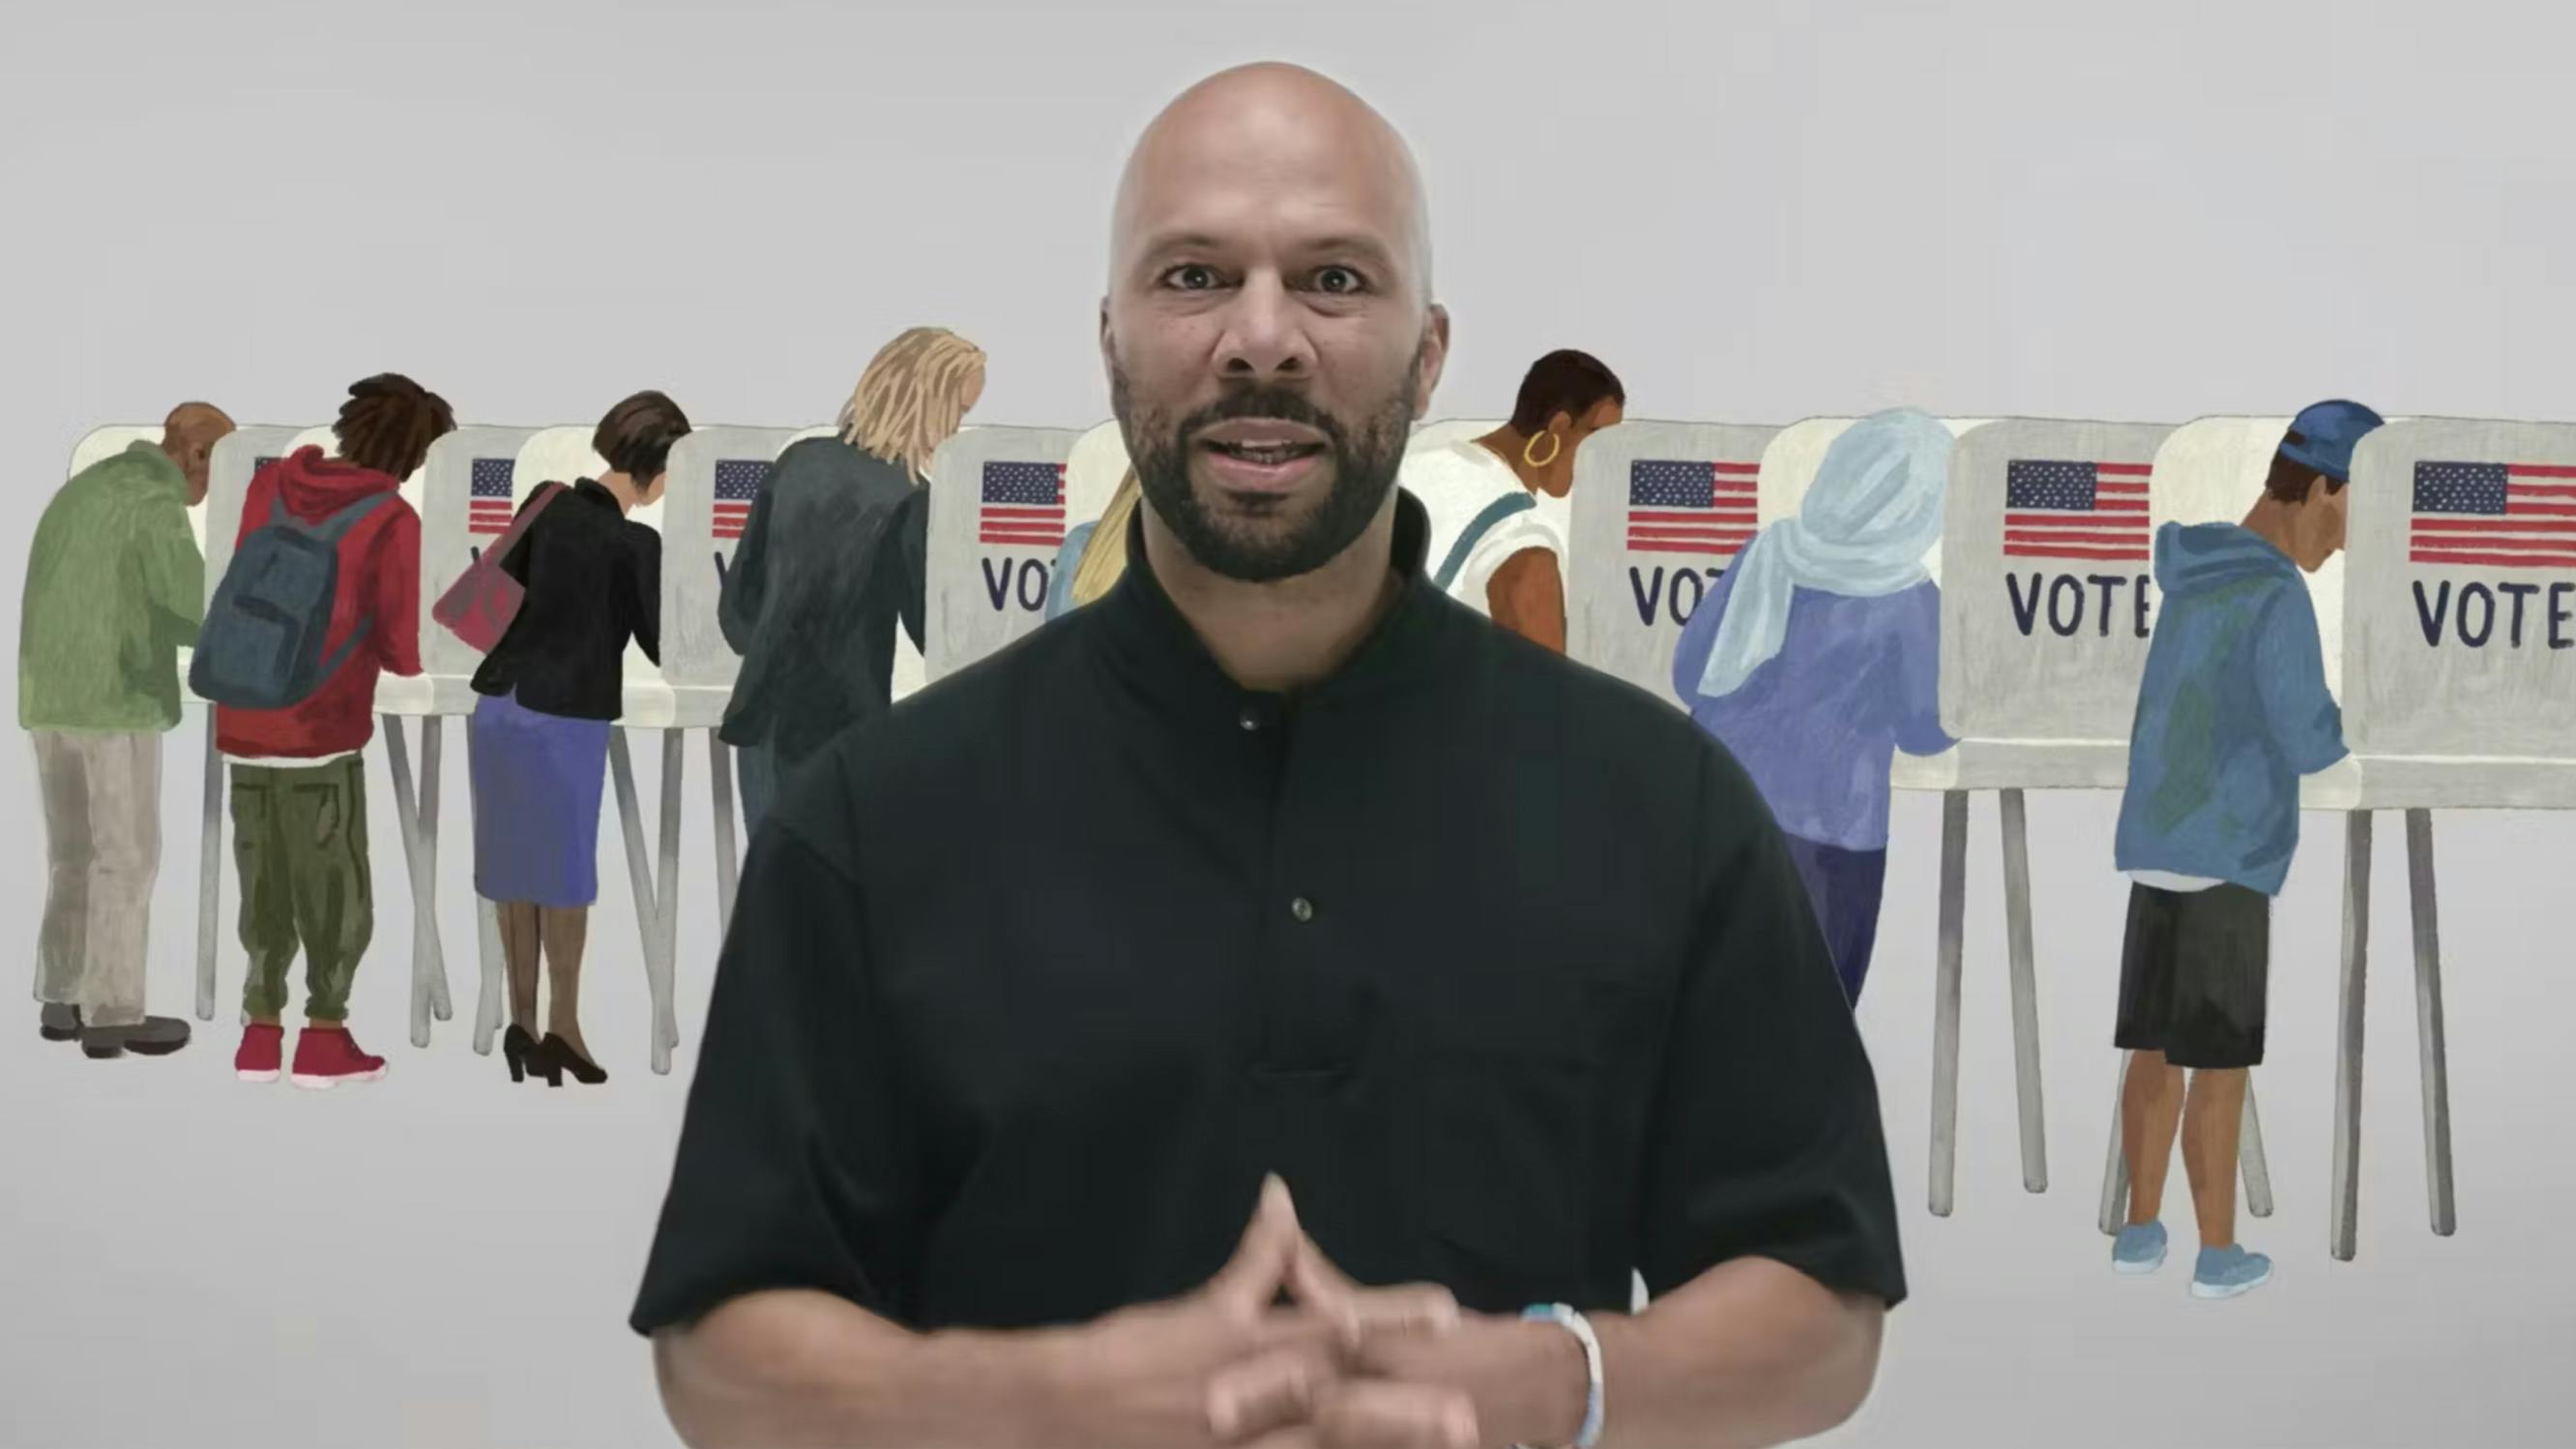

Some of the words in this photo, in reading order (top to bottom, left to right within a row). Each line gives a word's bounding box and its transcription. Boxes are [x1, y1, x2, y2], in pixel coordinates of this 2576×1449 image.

[981, 557, 1057, 611] VO
[1629, 566, 1725, 627] VO
[2006, 573, 2150, 638] VOTE
[2413, 580, 2575, 649] VOTE
